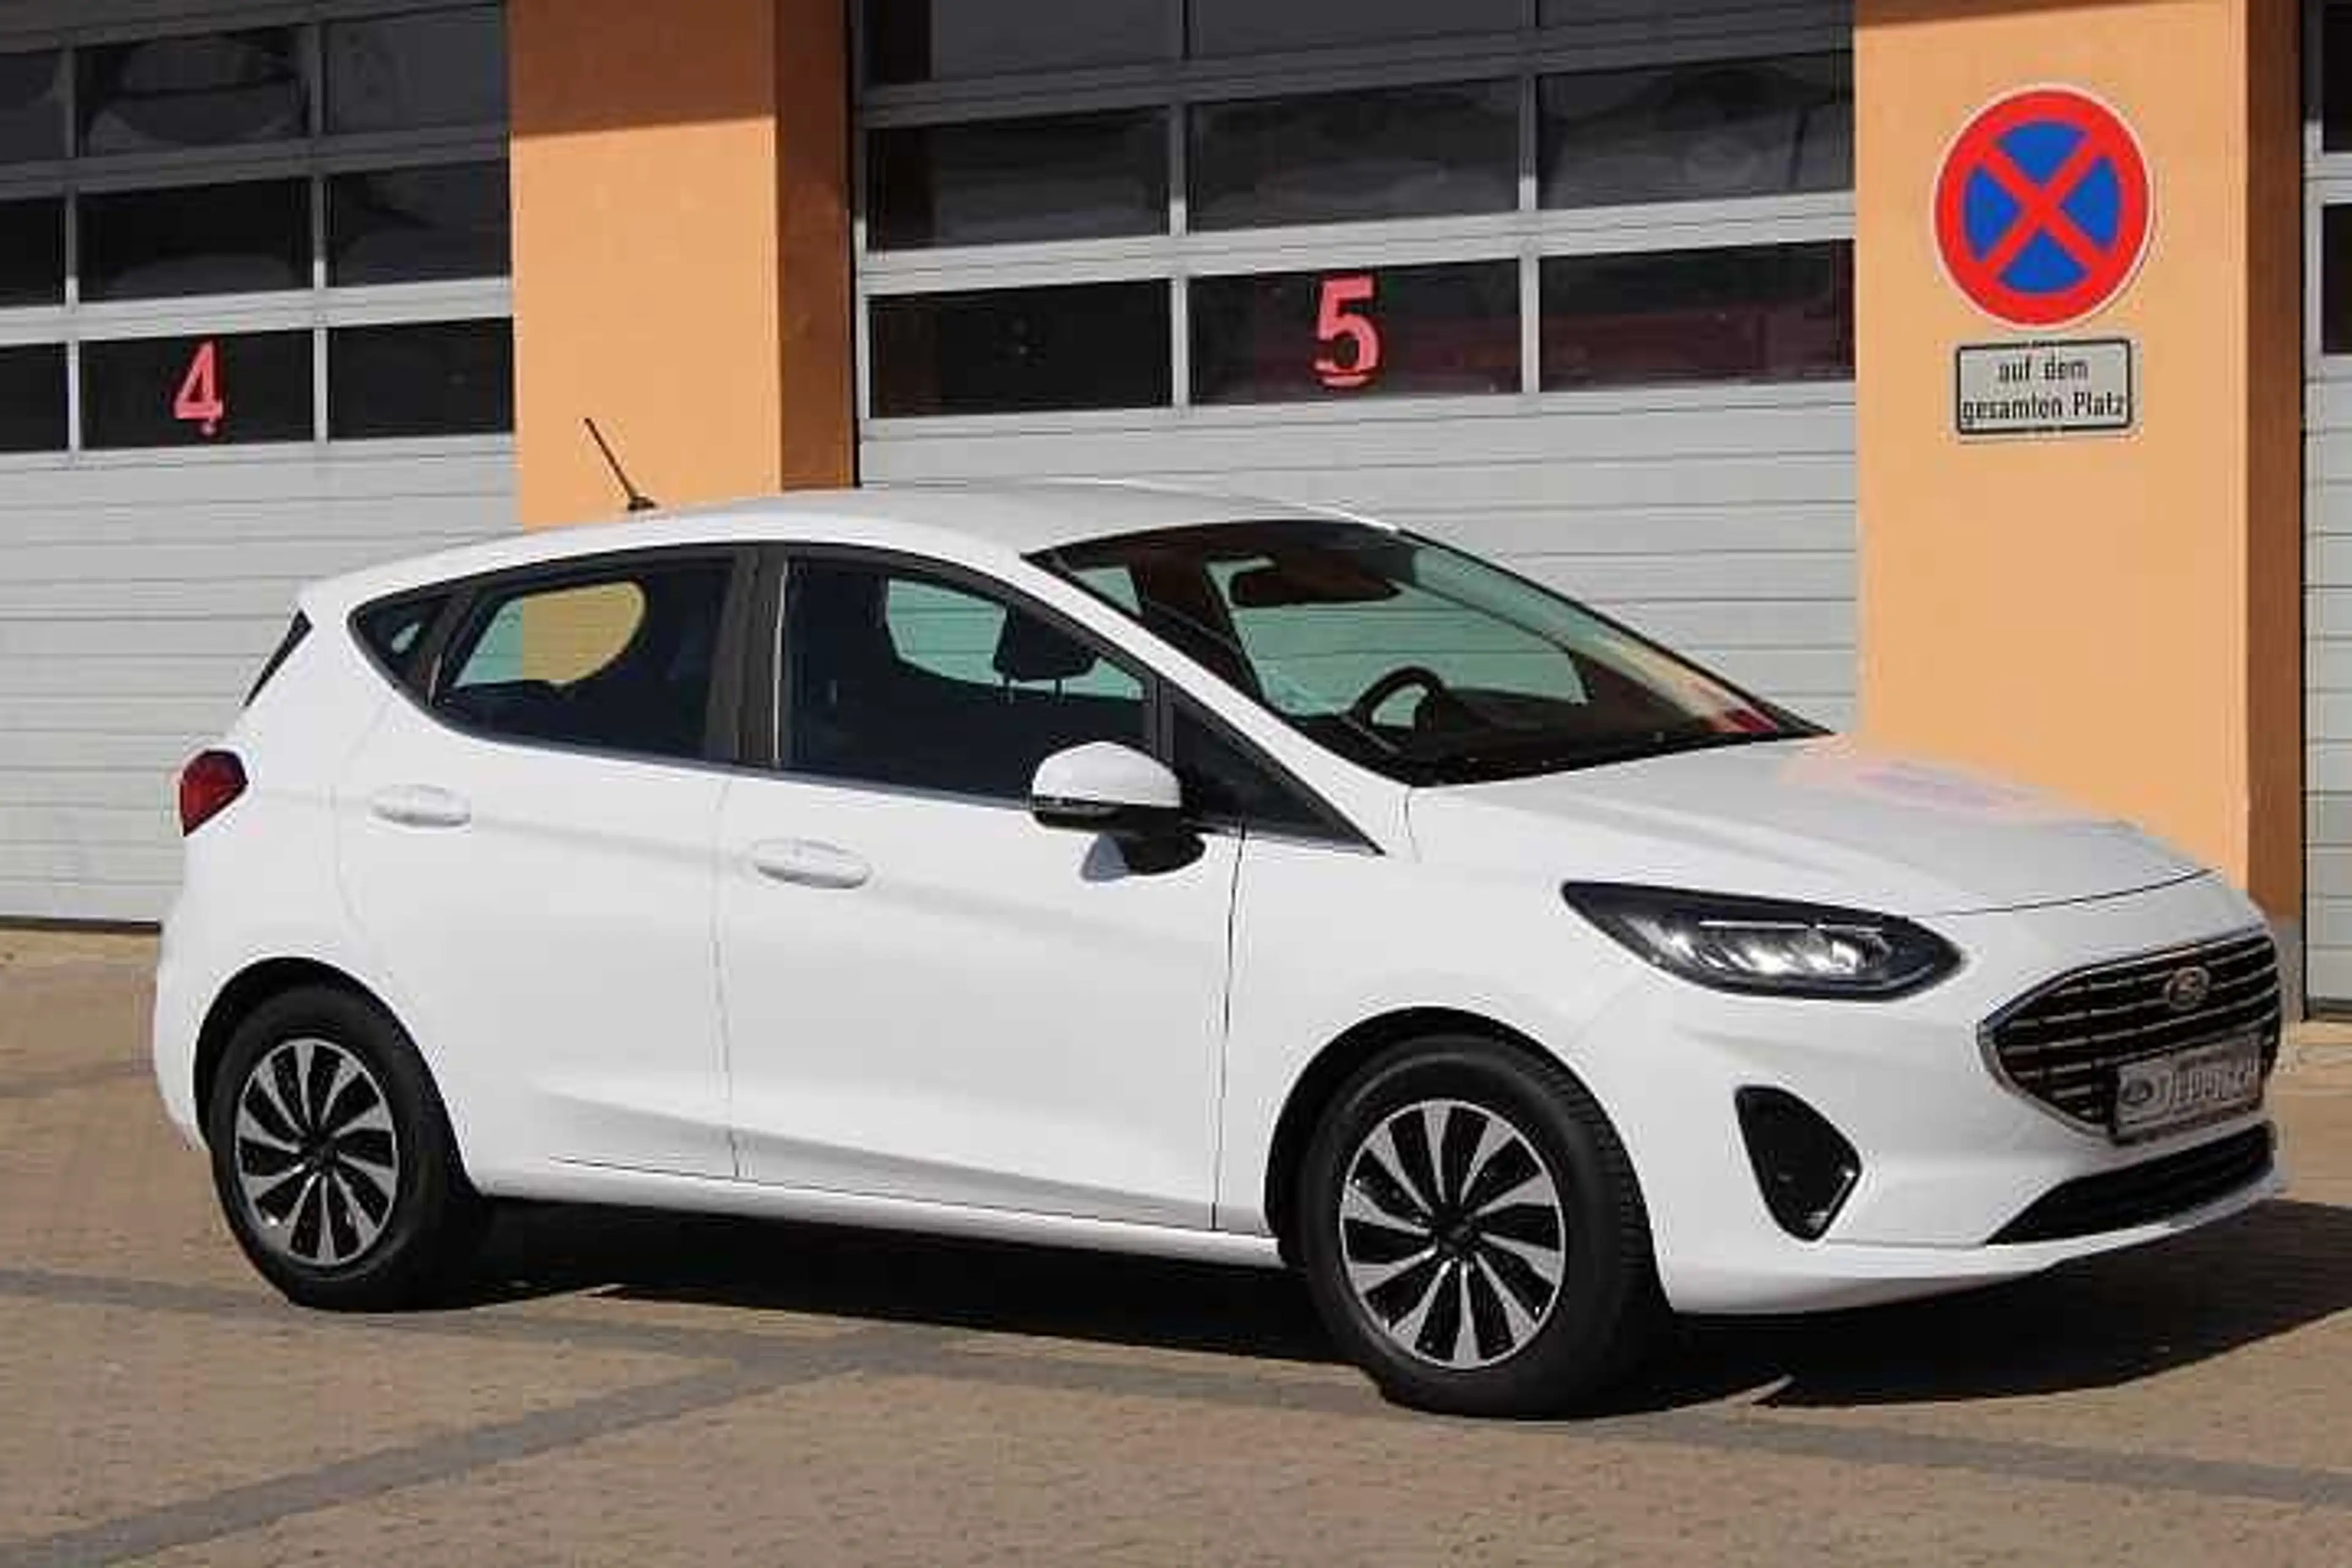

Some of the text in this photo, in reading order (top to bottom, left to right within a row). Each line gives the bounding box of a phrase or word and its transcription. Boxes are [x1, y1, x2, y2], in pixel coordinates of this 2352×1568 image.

[1315, 276, 1379, 386] 5
[174, 341, 224, 435] 4
[1999, 353, 2088, 382] auf dem
[1962, 391, 2124, 426] gesamten Platz
